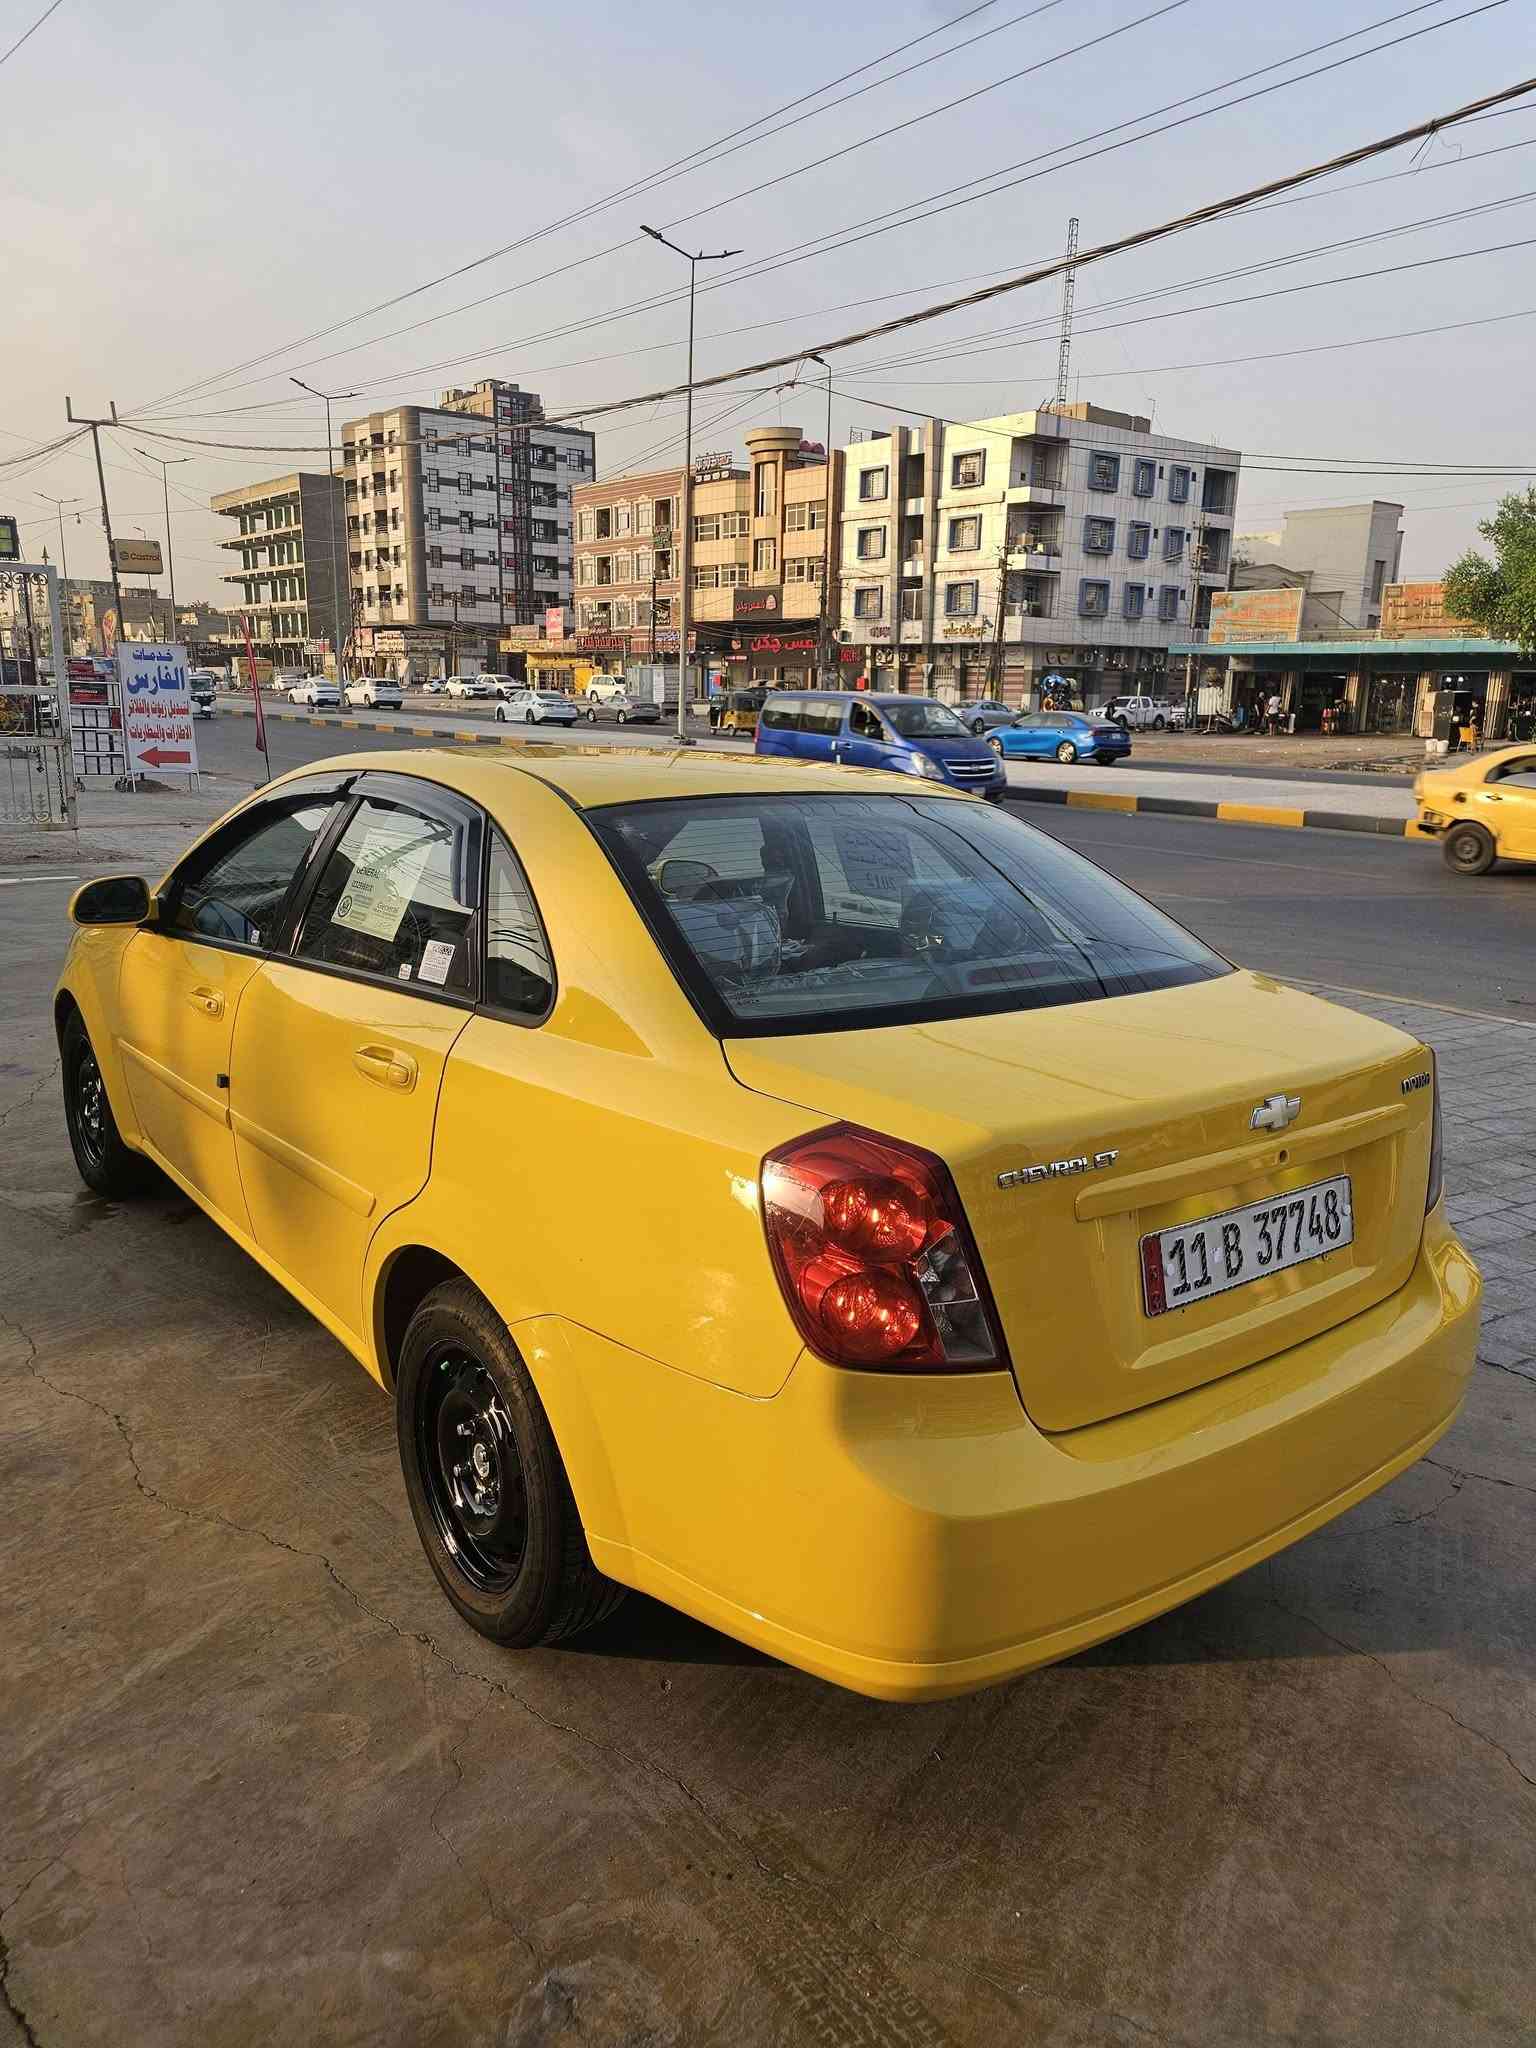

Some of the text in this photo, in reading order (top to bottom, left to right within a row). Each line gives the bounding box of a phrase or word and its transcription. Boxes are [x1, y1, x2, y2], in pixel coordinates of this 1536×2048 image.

[130, 552, 160, 561] Castrol
[132, 647, 174, 662] خدمات
[126, 665, 185, 695] الفارس
[998, 1149, 1119, 1189] CHEVROLET
[1169, 1231, 1212, 1297] 11
[1222, 1222, 1244, 1279] B
[1253, 1189, 1341, 1266] 37748
